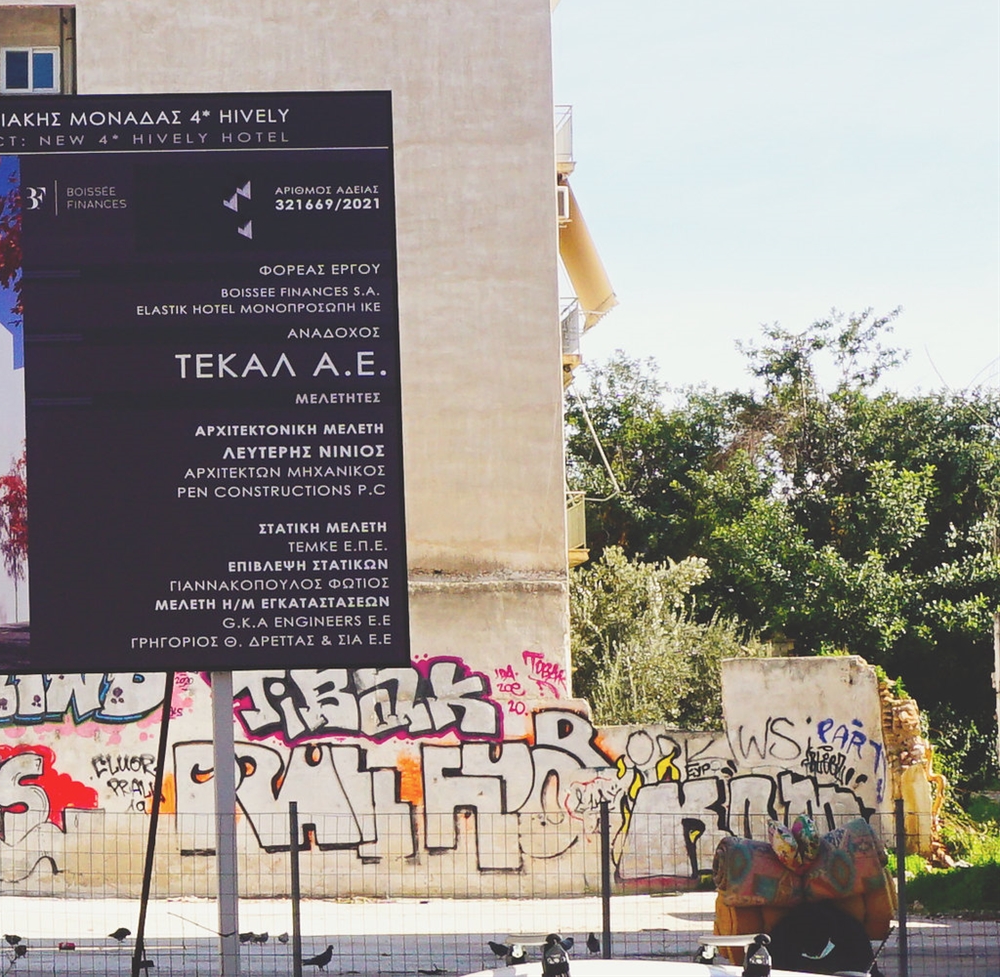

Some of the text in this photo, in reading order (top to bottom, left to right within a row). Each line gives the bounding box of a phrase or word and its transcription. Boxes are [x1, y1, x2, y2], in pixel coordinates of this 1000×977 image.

[69, 110, 182, 127] ΜΟΝΑΔΑΣ
[219, 108, 290, 124] HIVELY
[39, 135, 85, 146] NEW
[132, 133, 208, 145] HIVELY
[222, 131, 289, 143] HOTEL
[274, 185, 379, 195] ΑΡΙΘΜΟΣ ΑΔΕΙΑΣ
[67, 199, 127, 209] FINANCES
[275, 197, 380, 212] 321669/2021
[259, 263, 381, 276] ΦΟΡΕΑΣ ΕΡΓΟΥ
[221, 286, 380, 298] BOISSEE FINANCES S.A.
[136, 304, 188, 316] ELASTIK
[192, 304, 236, 315] HOTEL
[240, 302, 356, 314] ΜΟΝΟΠΡΟΣΩΠΗ
[287, 326, 380, 339] ΑΝΑΔΟΧΟΣ
[174, 352, 297, 379] ΤΕΚΑΛ
[295, 392, 381, 405] ΜΕΛΕΤΗΤΕΣ
[194, 422, 384, 437] ΑΡΧΙΤΕΚΤΟΝΙΚΗ ΜΕΛΕΤΗ
[222, 444, 385, 460] ΛΕΥΤΕΡΗΣ ΝΙΝΙΟΣ
[183, 464, 386, 480] ΑΡΧΙΤΕΚΤΩΝ ΜΗΧΑΝΙΚΟΣ
[177, 486, 208, 499] PEN
[214, 484, 352, 498] CONSTRUCTIONS
[258, 521, 387, 535] ΣΤΑΤΙΚΗ ΜΕΛΕΤΗ
[288, 540, 338, 553] ΤΕΜΚΕ
[228, 558, 389, 573] ΕΠΙΒΛΕΨΗ ΣΤΑΤΙΚΩΝ
[170, 577, 390, 592] ΓΙΑΝΝΑΚΟΠΟΥΛΟΣ ΦΩΤΙΟΣ
[154, 598, 216, 611] ΜΕΛΕΤΗ
[261, 595, 390, 610] ΕΓΚΑΤΑΣΤΑΣΕΩΝ
[222, 617, 269, 629] G.K.A
[274, 615, 362, 628] ENGINEERS
[131, 635, 219, 649] ΓΡΗΓΟΡΙΟΣ
[223, 636, 243, 648] Θ.
[248, 634, 315, 647] ΔΡΕΤΤΑΣ
[321, 635, 333, 646] &
[338, 634, 363, 646] ΣΙΑ
